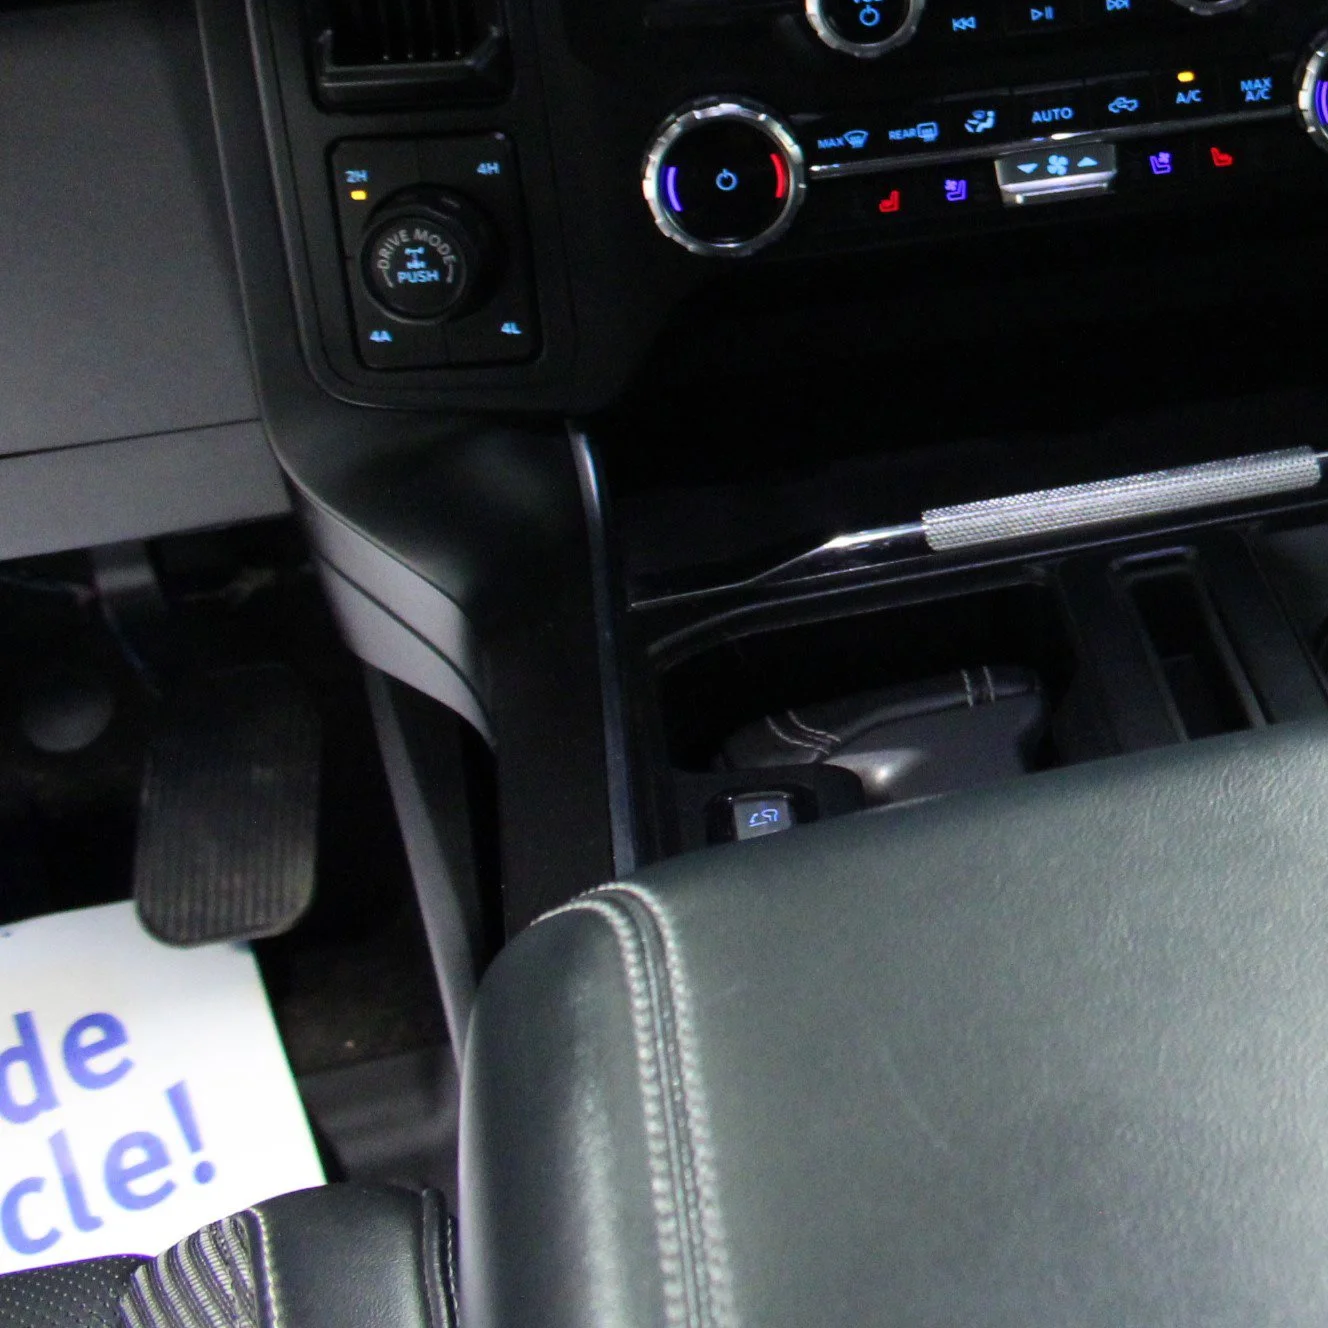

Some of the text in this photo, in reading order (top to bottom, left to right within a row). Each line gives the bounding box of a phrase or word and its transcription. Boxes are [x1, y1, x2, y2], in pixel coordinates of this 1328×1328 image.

[1240, 76, 1273, 92] MAX
[1175, 88, 1203, 105] A/C
[1245, 87, 1271, 103] A/C
[1031, 105, 1076, 123] AUTO
[888, 127, 917, 141] REAR
[817, 136, 845, 150] MAX
[476, 162, 500, 175] 4H
[345, 169, 368, 184] 2H
[376, 227, 457, 271] DRIVE MODE
[396, 270, 440, 284] PUSH
[501, 322, 522, 335] 4L
[369, 330, 393, 343] 4A
[1, 1079, 217, 1255] cle!
